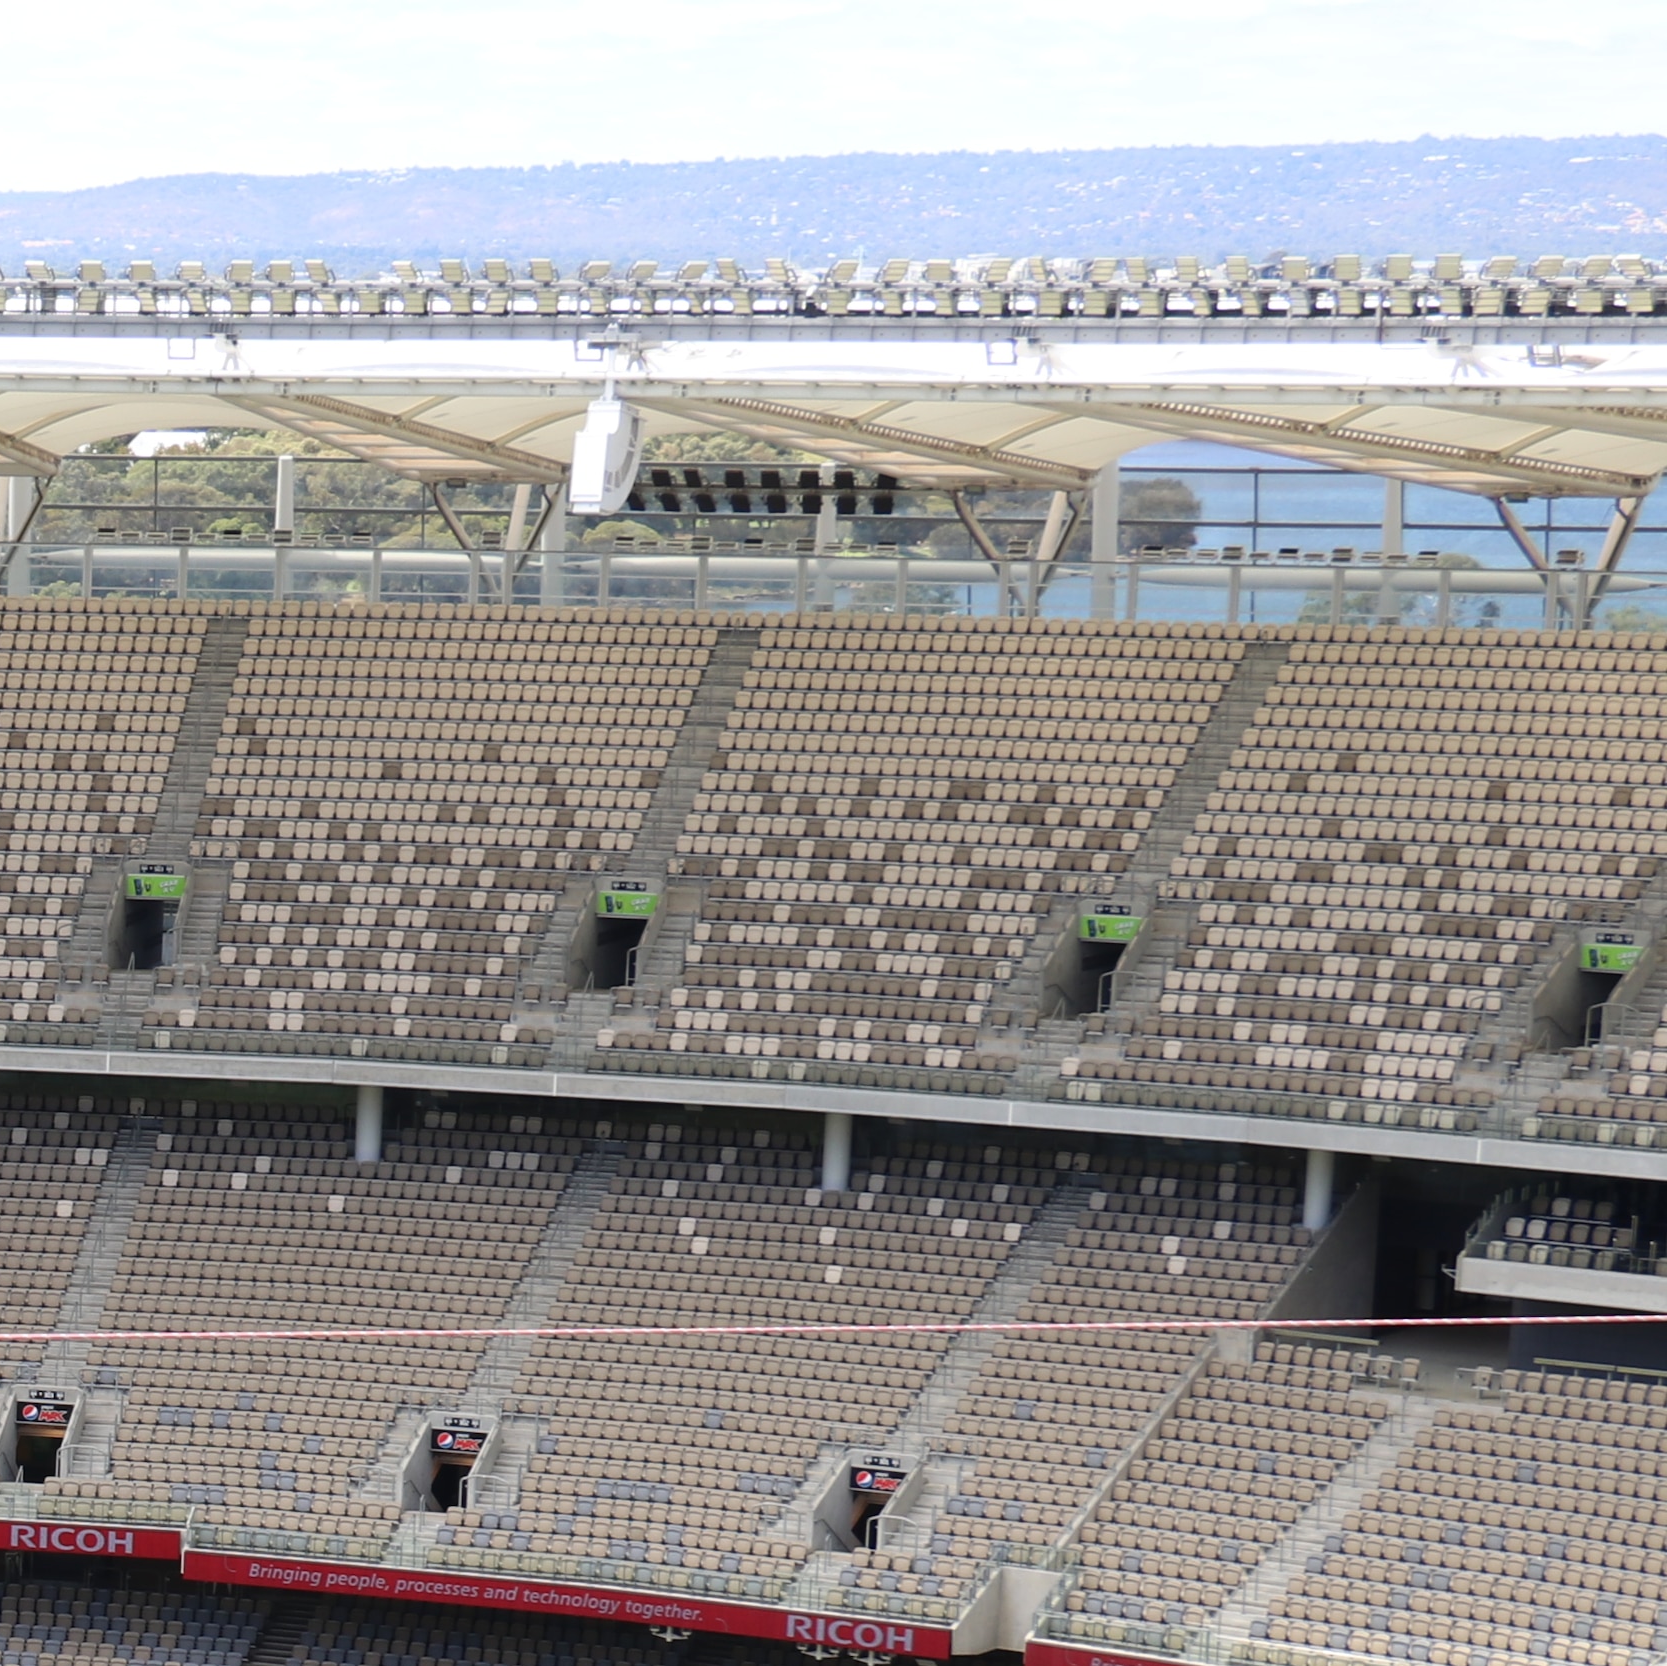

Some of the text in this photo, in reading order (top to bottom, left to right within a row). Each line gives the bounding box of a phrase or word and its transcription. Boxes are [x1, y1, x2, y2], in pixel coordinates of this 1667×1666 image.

[10, 1524, 134, 1554] RICOH
[249, 1563, 704, 1622] Bringing people, processes and technology together.
[786, 1614, 914, 1652] RICOH
